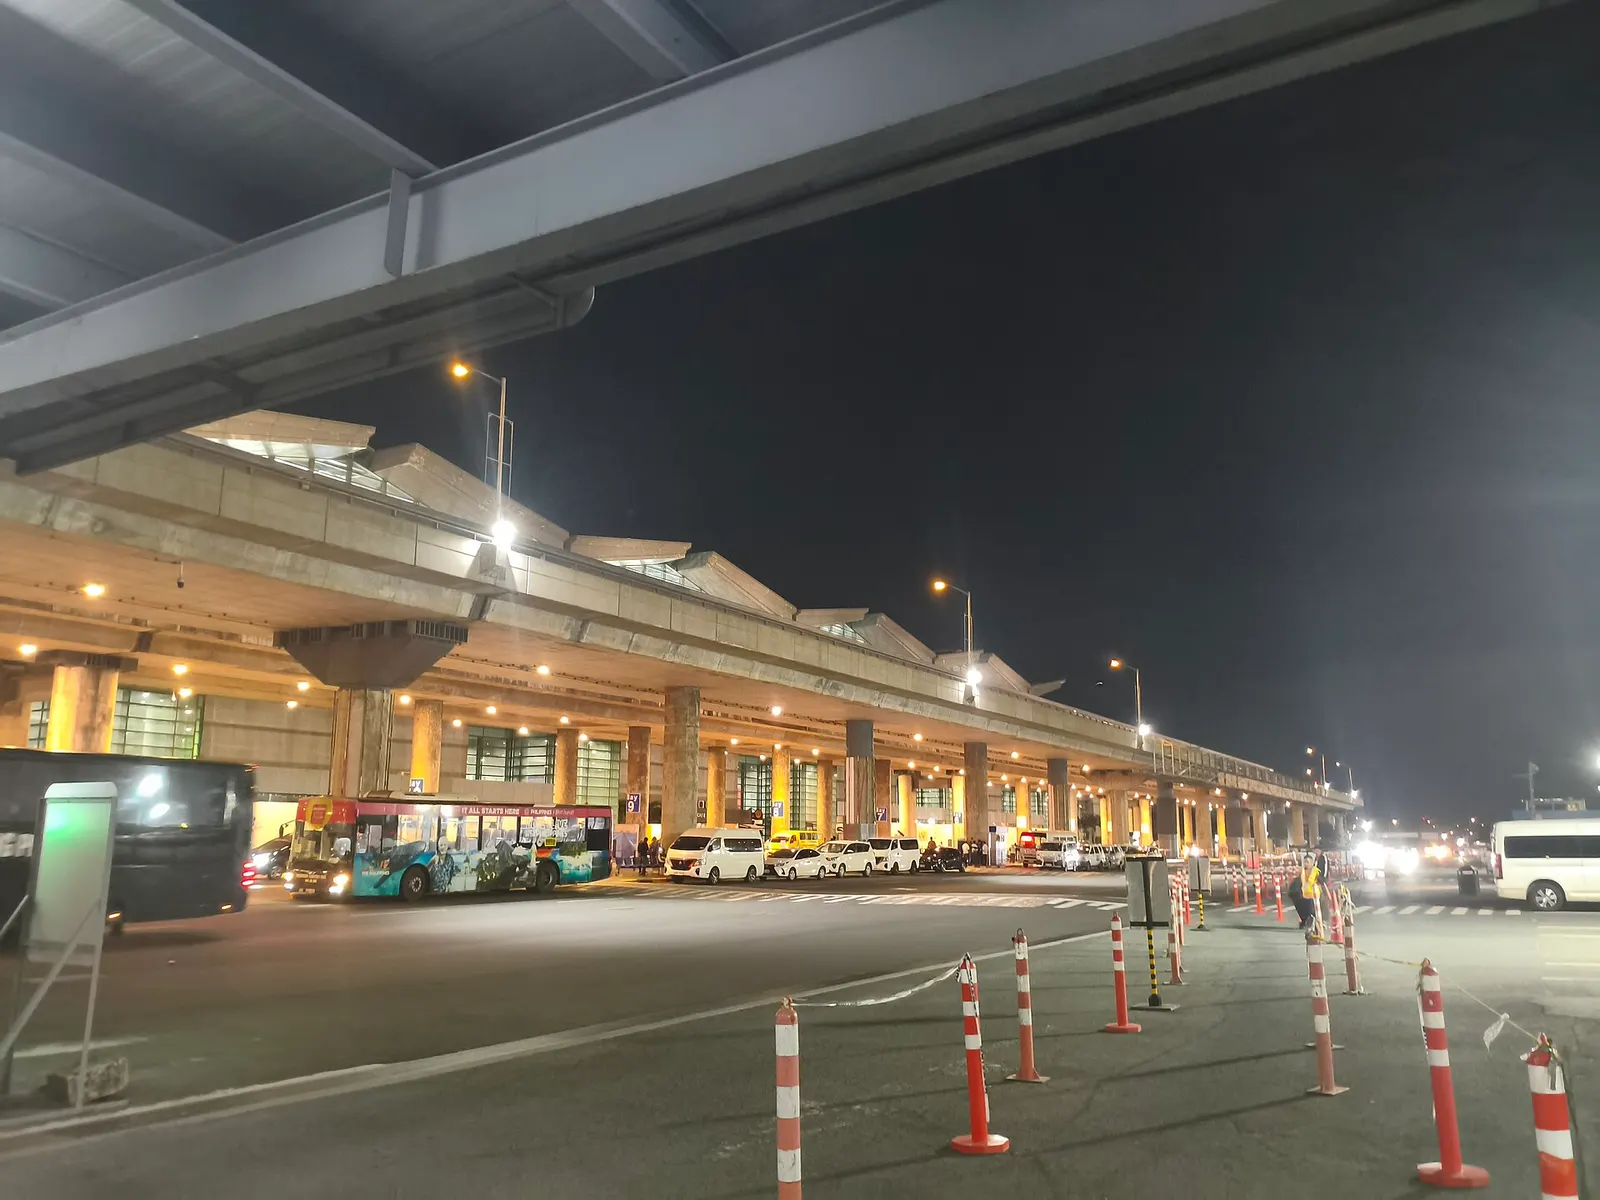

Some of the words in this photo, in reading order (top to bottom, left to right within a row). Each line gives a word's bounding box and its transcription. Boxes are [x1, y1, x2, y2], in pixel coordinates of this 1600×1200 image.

[628, 801, 634, 812] 9
[461, 807, 468, 815] IT
[468, 807, 480, 815] ALL
[481, 807, 503, 816] STARTS
[504, 808, 520, 816] HERE
[773, 807, 779, 817] 8
[877, 813, 883, 822] 7
